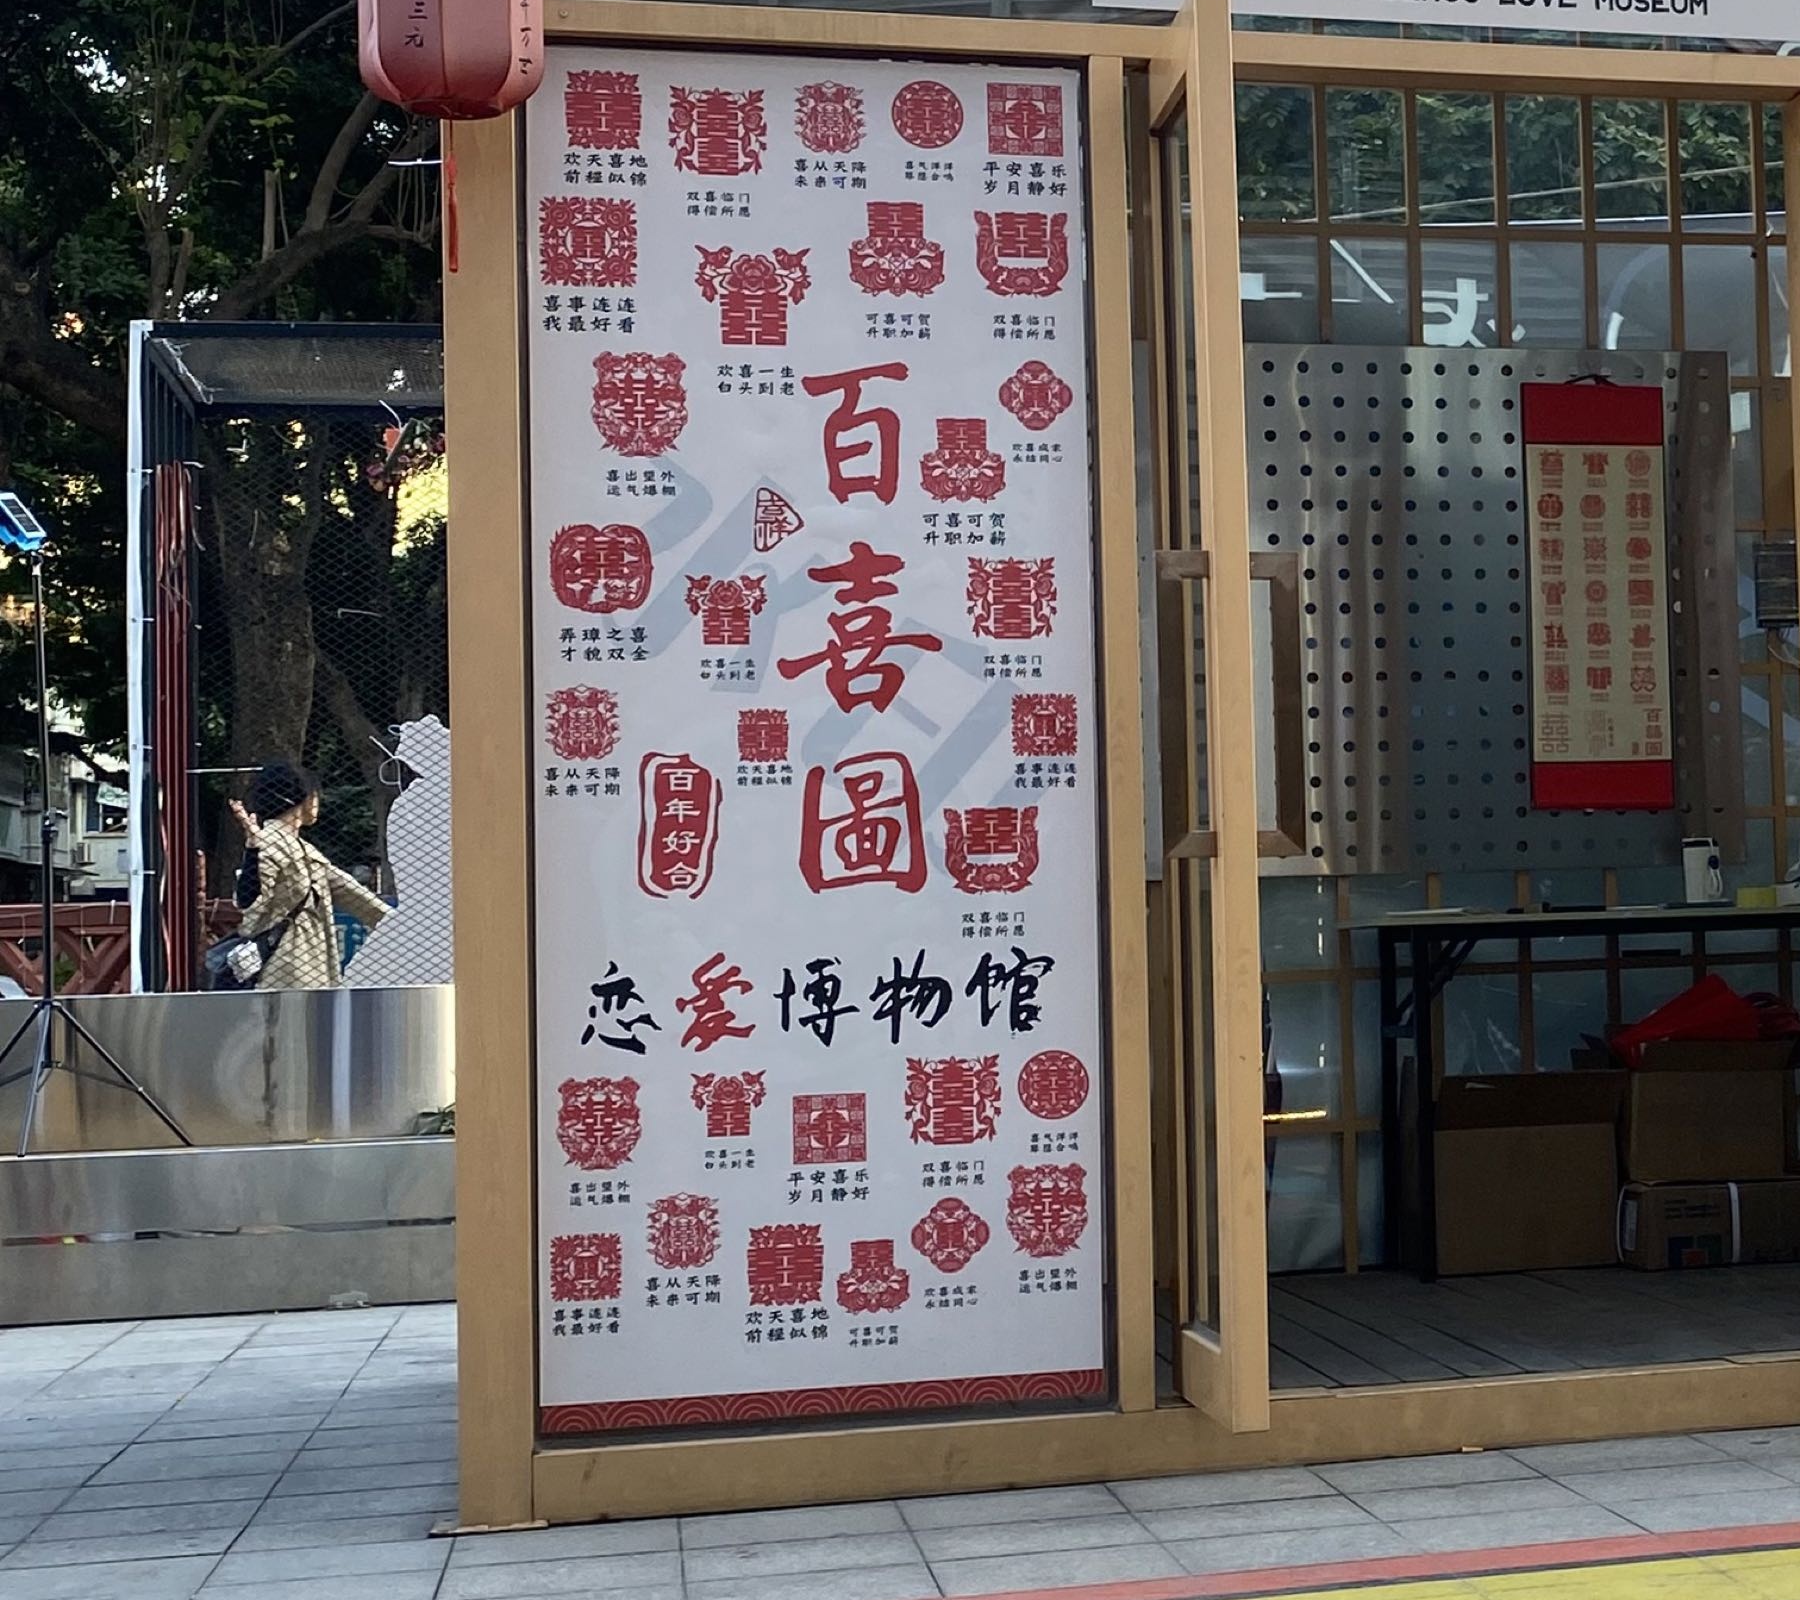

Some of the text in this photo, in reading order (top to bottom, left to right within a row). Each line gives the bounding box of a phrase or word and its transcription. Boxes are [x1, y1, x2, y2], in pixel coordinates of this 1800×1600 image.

[563, 152, 648, 168] 欢天喜地
[794, 159, 866, 173] 喜从天降
[983, 161, 1067, 178] 平安喜乐
[984, 180, 1068, 197] 岁月静好
[687, 191, 750, 203] 双喜临门
[543, 295, 637, 313] 喜事连连
[542, 316, 635, 333] 我最好看
[866, 313, 930, 326] 可喜可贺
[993, 314, 1056, 327] 双喜临门
[717, 364, 795, 378] 欢喜一生
[717, 381, 795, 395] 白头到老
[606, 469, 675, 482] 喜出望外
[922, 513, 1006, 528] 可喜可贺
[923, 531, 1006, 547] 升职加薪
[560, 646, 650, 662] 才貌双全
[545, 767, 620, 781] 喜从天降
[661, 767, 701, 887] 百年好合
[962, 912, 1025, 924] 双喜临门
[580, 945, 1056, 1055] 恋爱博物馆
[922, 1160, 985, 1173] 双喜临门
[787, 1168, 869, 1185] 平安喜乐
[788, 1185, 870, 1204] 岁月静好
[645, 1275, 721, 1291] 喜从天降
[745, 1307, 830, 1326] 欢天喜地
[745, 1324, 828, 1344] 前程似锦
